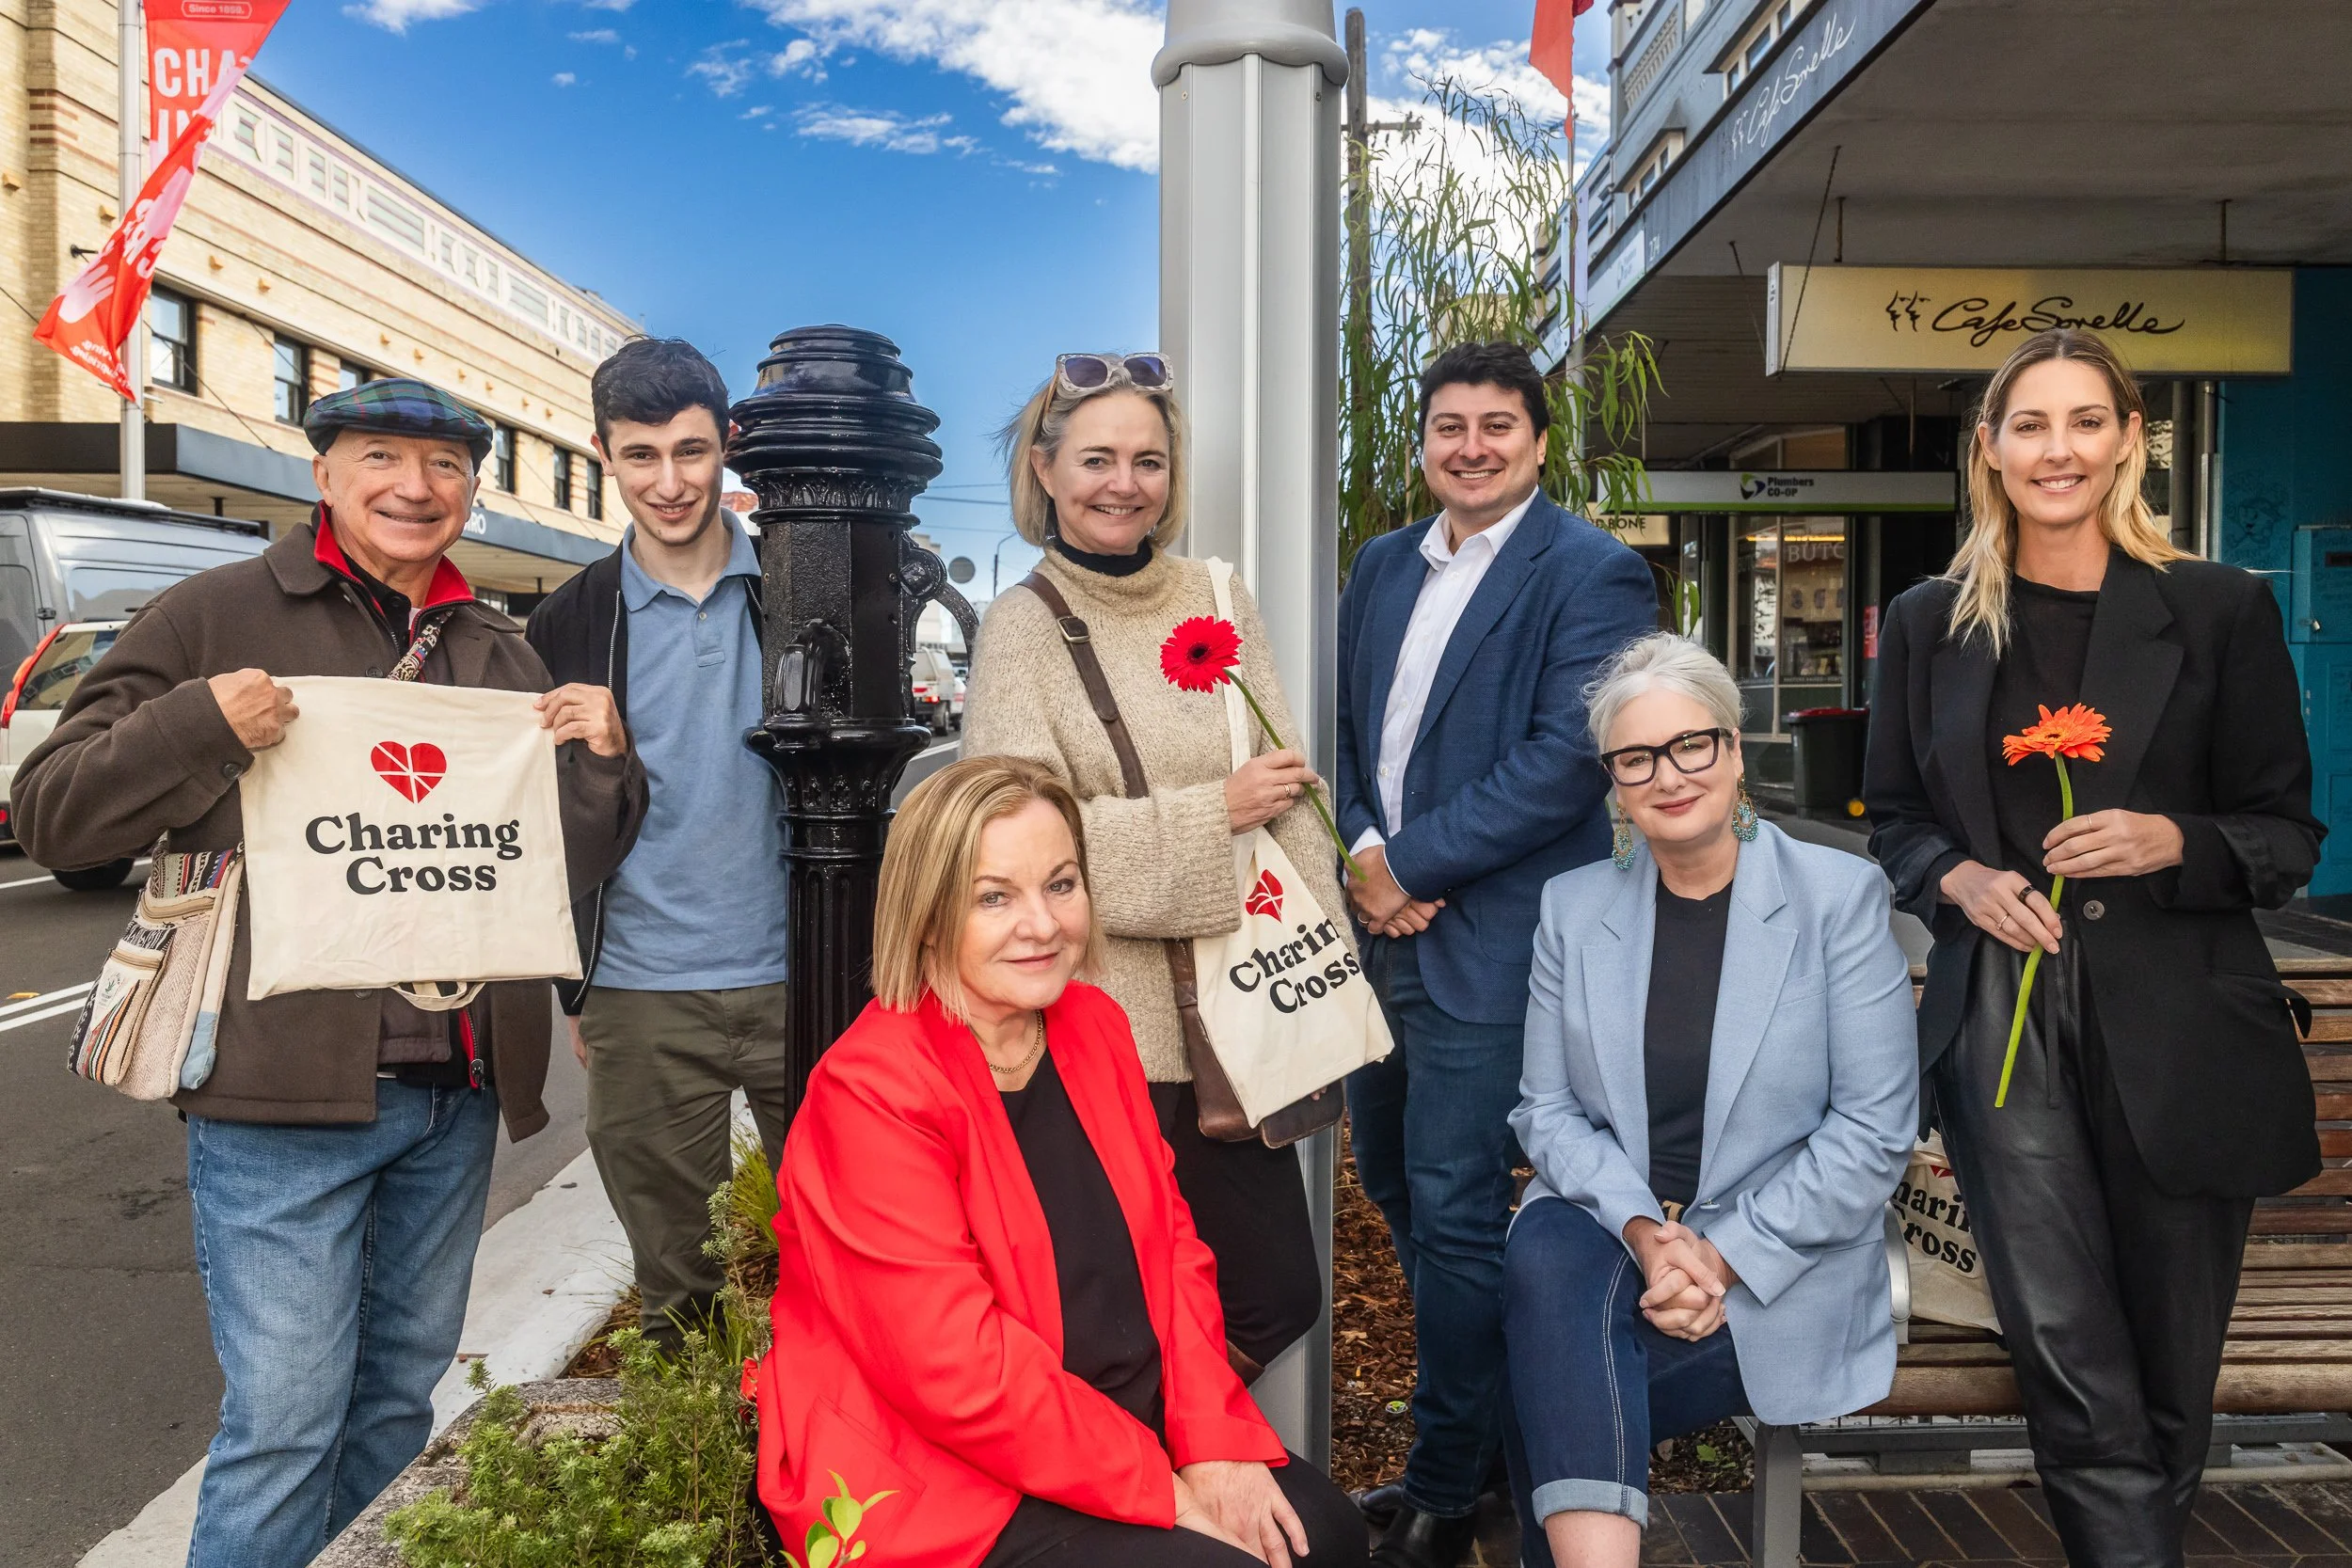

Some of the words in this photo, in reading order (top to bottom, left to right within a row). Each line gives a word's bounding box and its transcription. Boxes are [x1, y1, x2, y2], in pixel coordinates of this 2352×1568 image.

[188, 4, 216, 13] Since
[1931, 297, 2024, 347] Cafe
[2021, 296, 2185, 335] Sorelle
[1767, 477, 1815, 487] Plumbers
[1767, 487, 1799, 498] CO-OP
[1608, 517, 1646, 530] BONE
[305, 812, 523, 861] Charing
[345, 856, 497, 895] Cross
[1269, 952, 1361, 1014] Cross
[1893, 1204, 1977, 1274] ross
